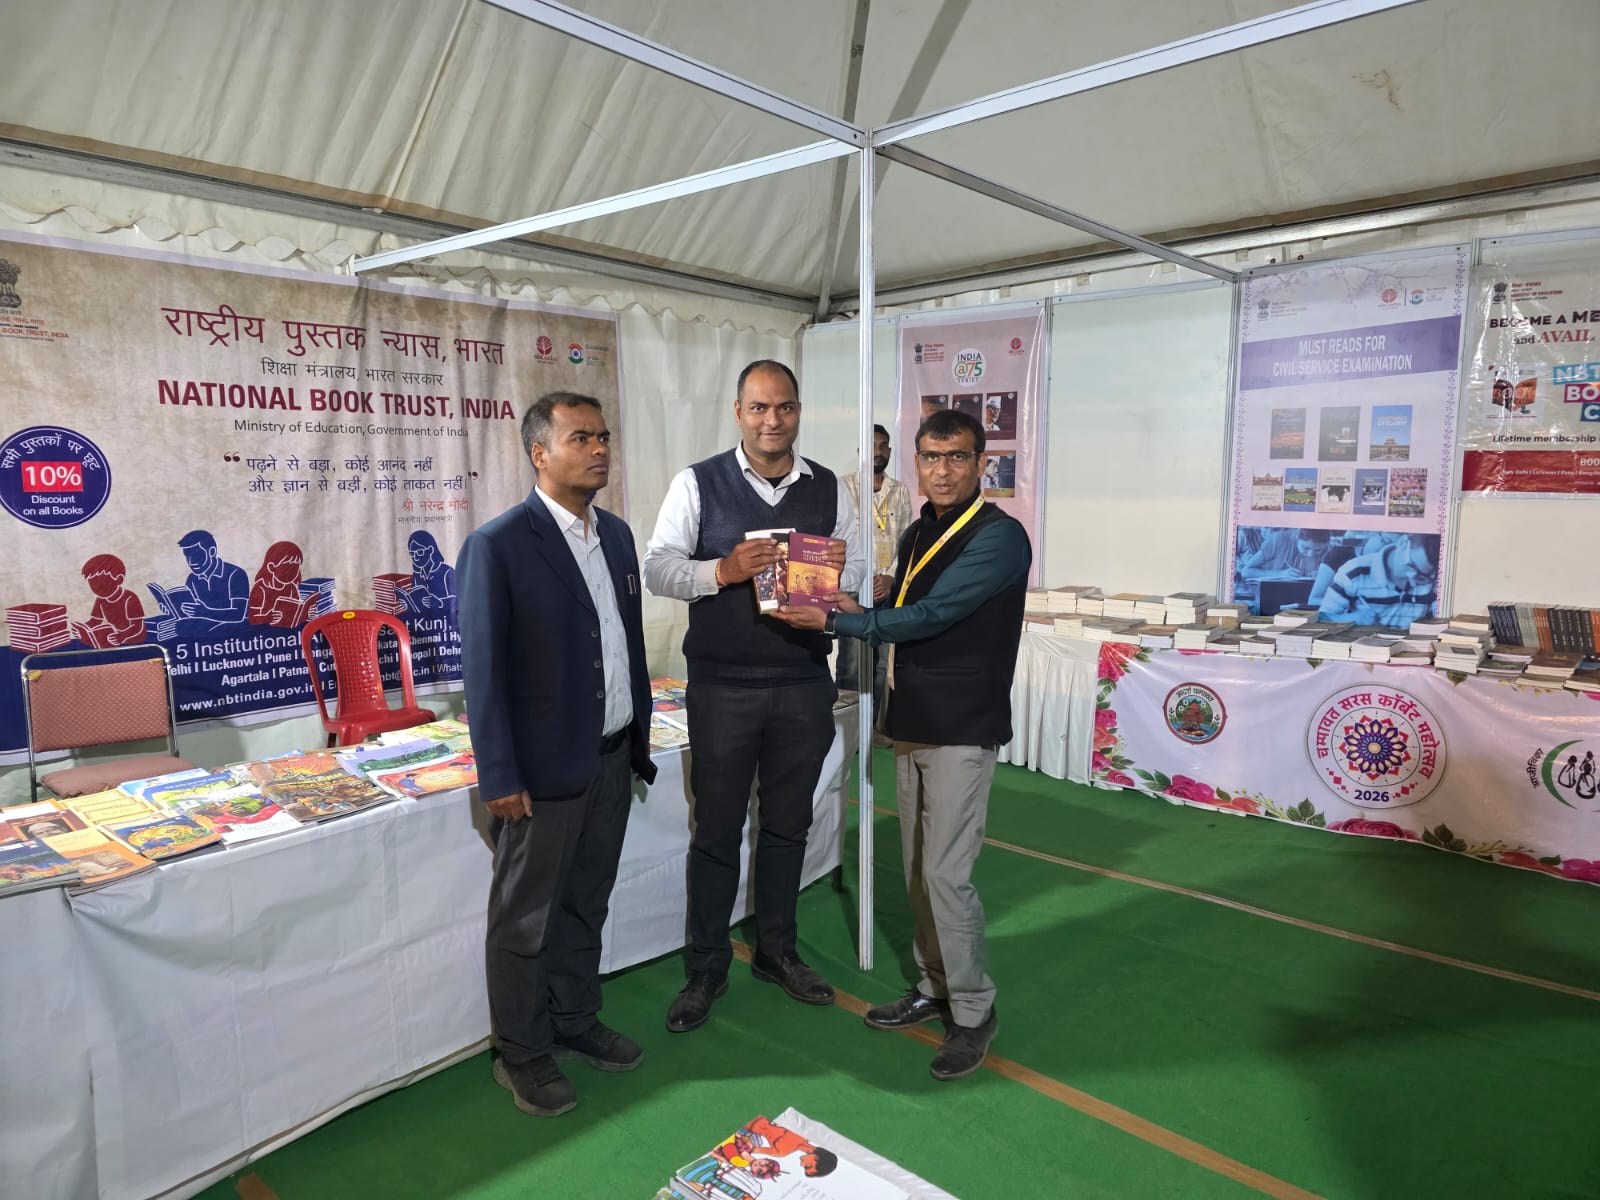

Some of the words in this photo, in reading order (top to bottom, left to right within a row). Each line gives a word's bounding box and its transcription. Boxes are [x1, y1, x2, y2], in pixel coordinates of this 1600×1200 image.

[1556, 314, 1568, 325] A
[161, 304, 265, 347] राष्ट्रीय
[282, 320, 367, 357] पुस्तक
[380, 330, 447, 363] न्यास,
[453, 338, 505, 365] भारत
[1538, 329, 1596, 344] AVAIL
[1298, 339, 1328, 356] MUST
[1328, 336, 1363, 354] READS
[1364, 335, 1387, 351] FOR
[957, 352, 982, 361] INDIA
[1272, 361, 1297, 377] CIVIL
[1298, 358, 1341, 376] SERVICE
[1341, 354, 1414, 374] EXAMINATION
[261, 356, 298, 376] शिक्षा
[365, 368, 396, 384] भारत
[400, 371, 444, 387] सरकार
[954, 361, 983, 378] @75
[157, 379, 302, 412] NATIONAL
[310, 388, 375, 415] BOOK
[380, 392, 454, 420] TRUST,
[461, 397, 516, 420] INDIA
[234, 419, 286, 436] Ministry
[289, 421, 303, 433] of
[305, 422, 366, 437] Education,
[367, 424, 431, 437] Government
[433, 425, 445, 437] of
[447, 429, 469, 438] India
[1492, 434, 1532, 443] Lifetime
[1, 447, 22, 470] सभी
[19, 432, 63, 455] पुस्तकों
[67, 439, 85, 455] पर
[82, 451, 102, 472] छूट
[246, 454, 277, 474] पढ़ने
[285, 454, 301, 471] से
[307, 459, 337, 474] बड़ा,
[344, 455, 370, 473] कोई
[377, 456, 408, 472] आनंद
[413, 456, 434, 472] नहीं
[25, 465, 82, 487] 10%
[249, 474, 275, 493] और
[281, 480, 311, 494] ज्ञान
[317, 474, 329, 492] से
[374, 475, 398, 493] कोई
[403, 479, 435, 491] ताकत
[31, 495, 76, 504] Discount
[448, 497, 470, 512] मोदी
[22, 508, 37, 516] on
[38, 506, 50, 516] all
[52, 506, 84, 516] Books
[176, 643, 189, 660] 5
[194, 630, 302, 659] Institutional
[377, 640, 398, 650] kata
[170, 664, 192, 677] elhi
[202, 657, 255, 673] Lucknow
[265, 651, 292, 664] Pune
[378, 653, 393, 664] chi
[221, 671, 270, 688] Agartala
[279, 665, 309, 678] Patna
[1316, 706, 1341, 759] चम्पावत
[1338, 693, 1373, 711] सरस
[1378, 694, 1422, 722] कॉर्बेट
[1418, 721, 1441, 780] महोत्सव
[1354, 789, 1390, 802] 2026
